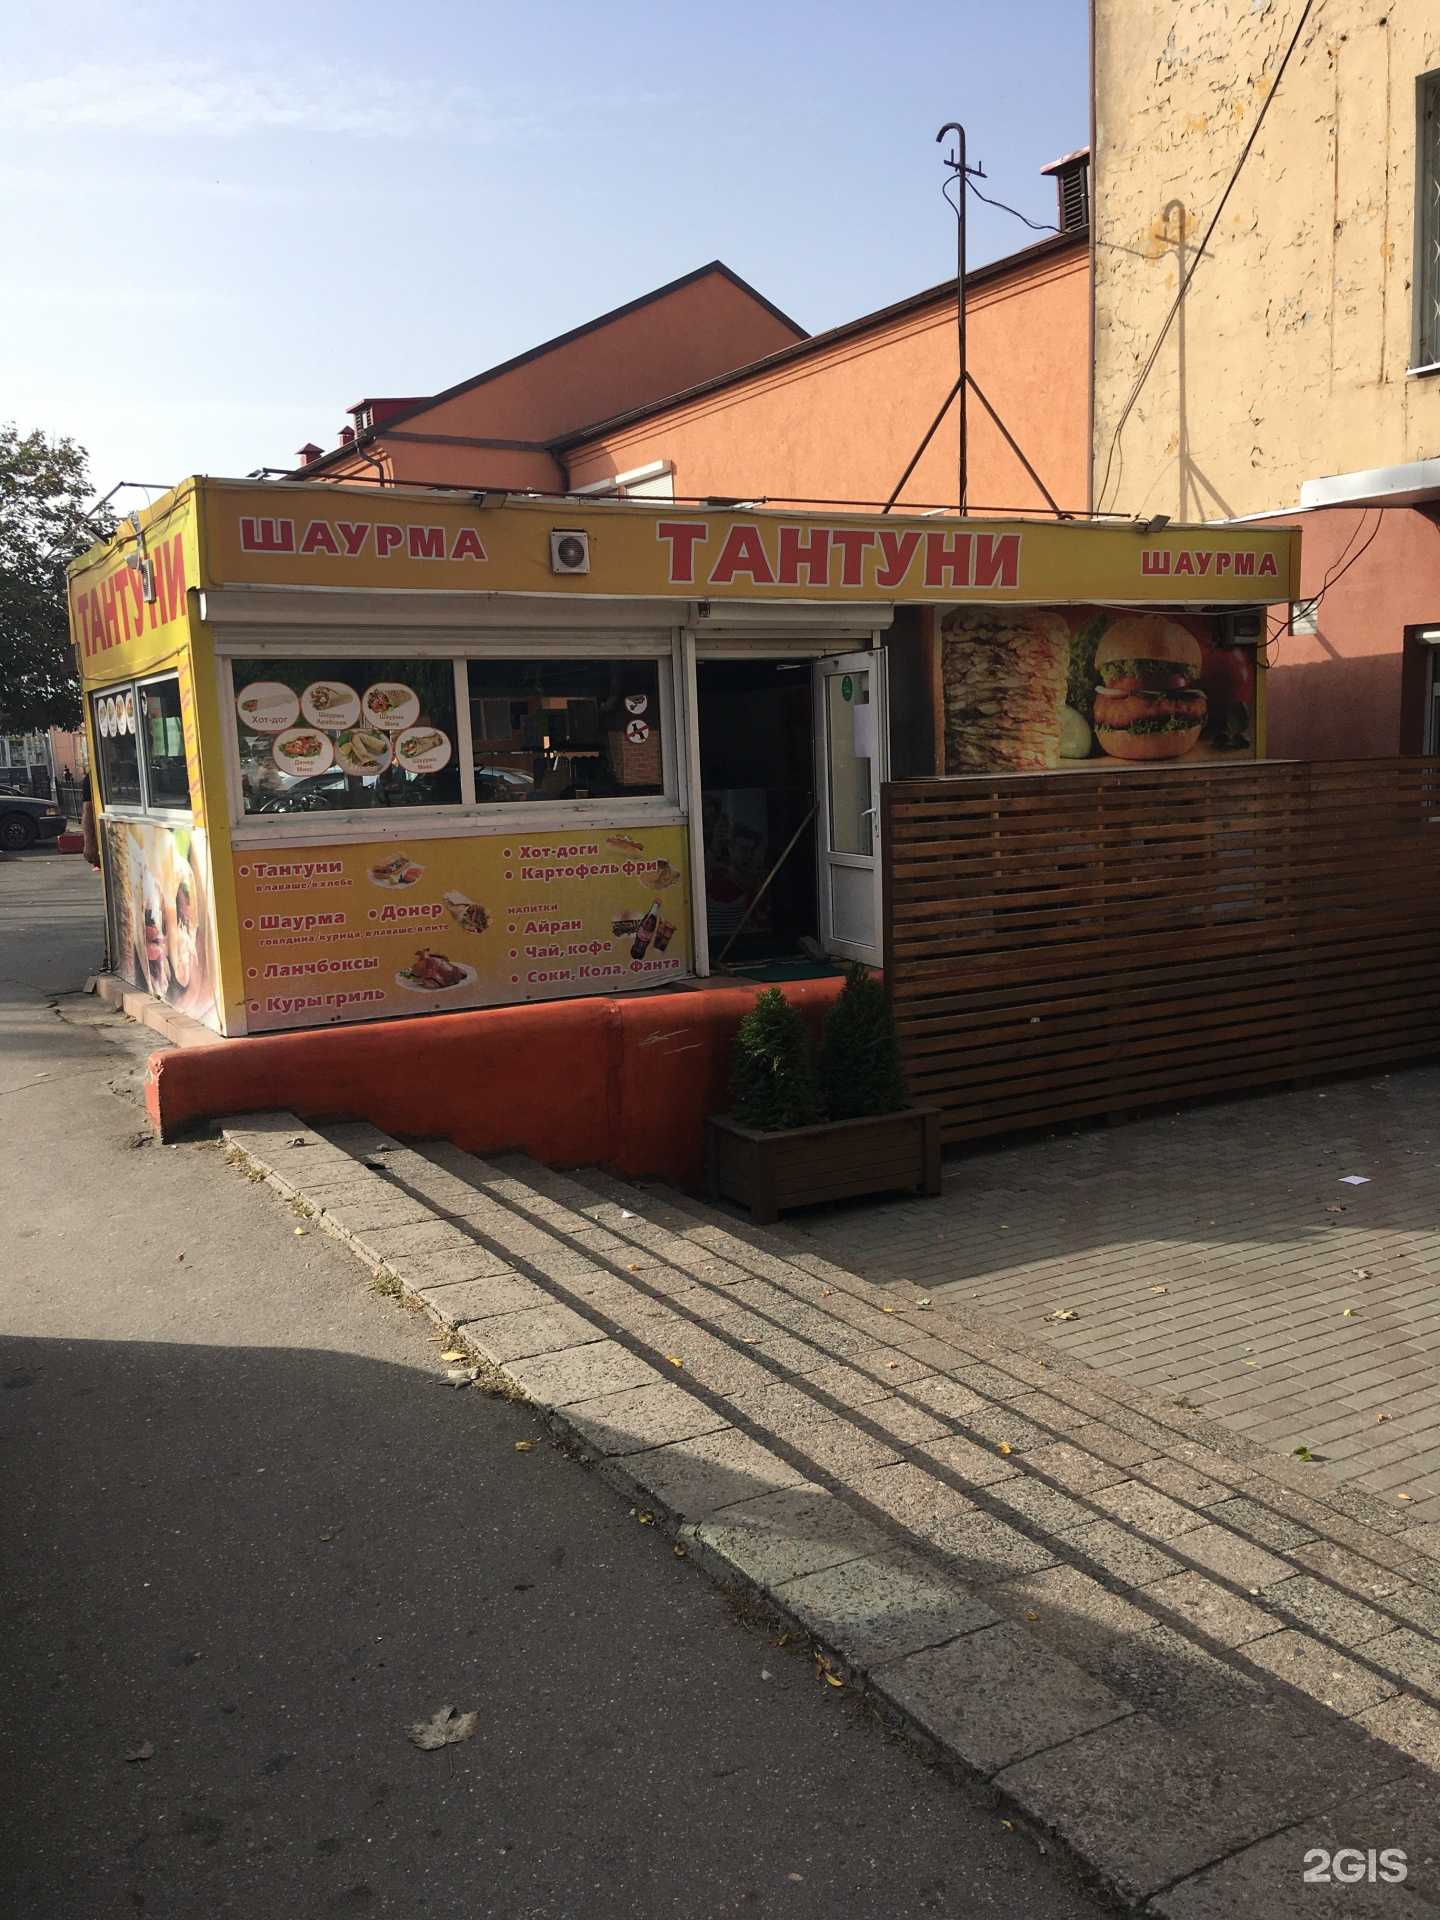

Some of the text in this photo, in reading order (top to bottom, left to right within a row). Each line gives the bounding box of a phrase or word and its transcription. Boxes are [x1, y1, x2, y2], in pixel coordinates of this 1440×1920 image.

[240, 517, 488, 561] ШАУРМА
[656, 520, 1022, 589] ТАНТУНИ
[1140, 549, 1279, 577] ШАУРМА
[77, 532, 187, 657] ТАНТУНИ
[252, 715, 288, 724] Хот-дог
[519, 843, 600, 860] Хот-доги
[253, 860, 343, 879] Тантуни
[521, 859, 658, 883] Картофель фри
[259, 912, 345, 932] Шаурма
[380, 903, 443, 922] Донер
[524, 919, 583, 935] Айран
[526, 940, 613, 959] Чай, кофе
[263, 956, 379, 978] Ланчбоксы
[527, 958, 681, 984] Соки, Кола, Фанта
[266, 989, 386, 1015] Куры гриль
